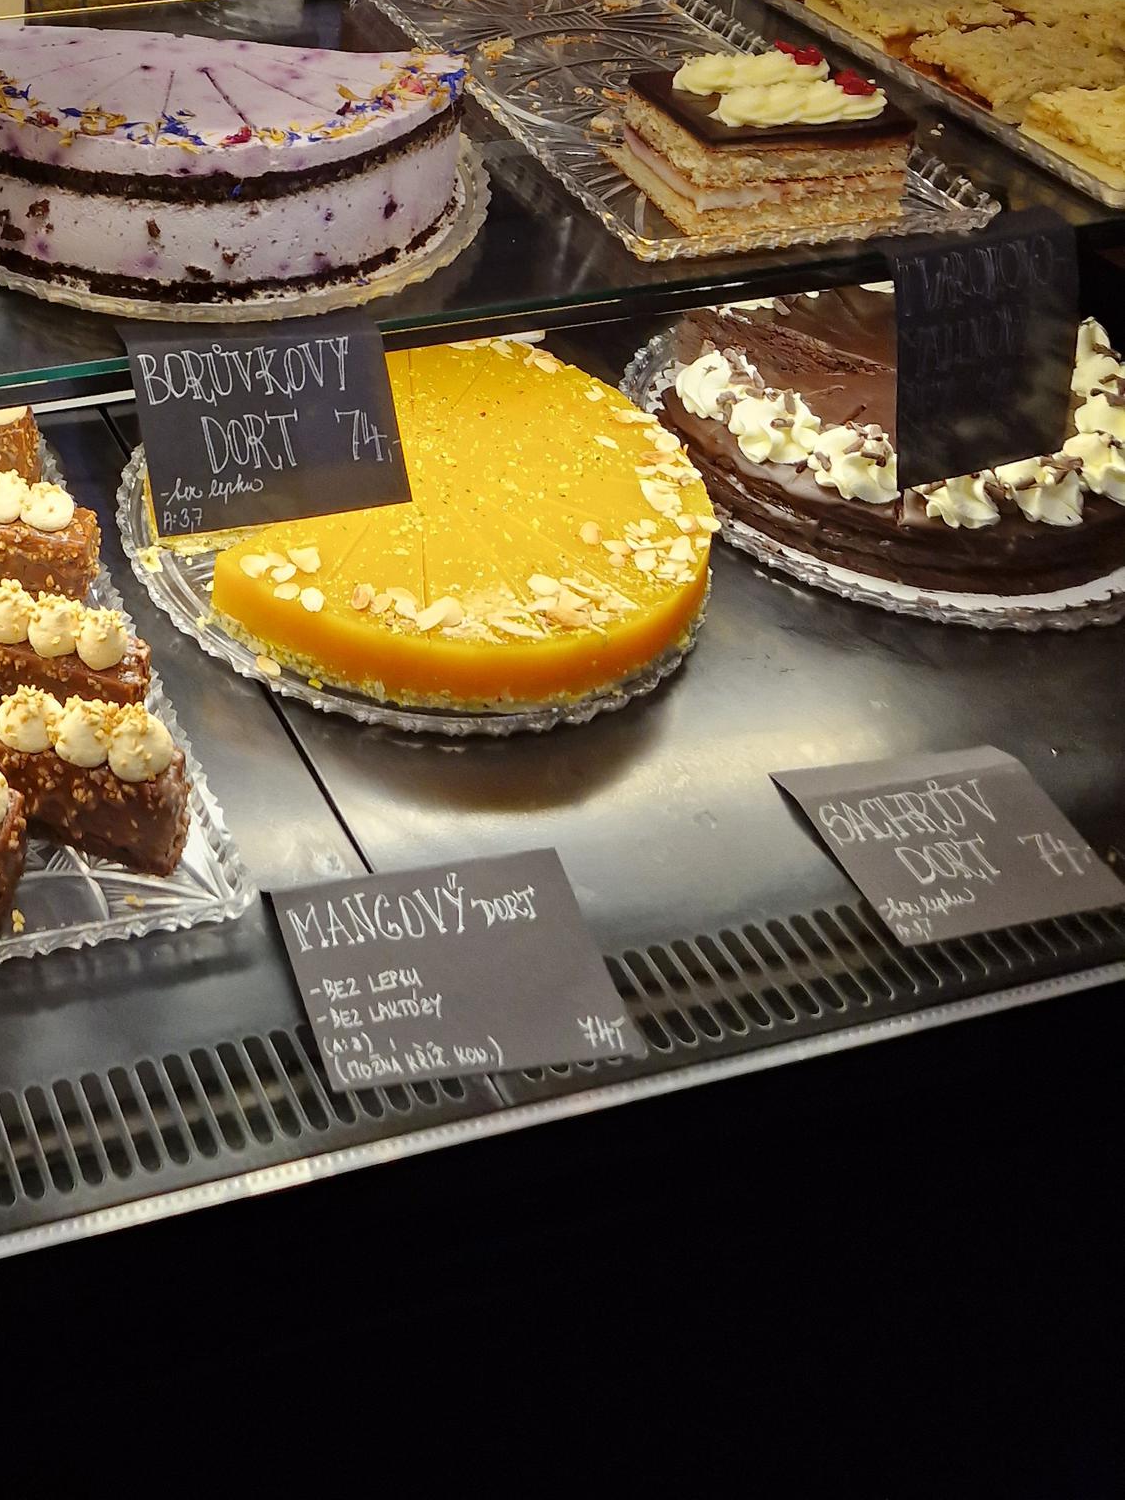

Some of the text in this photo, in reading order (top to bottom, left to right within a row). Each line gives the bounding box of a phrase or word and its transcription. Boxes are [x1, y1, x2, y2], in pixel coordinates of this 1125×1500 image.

[201, 408, 298, 475] DORT
[334, 408, 402, 464] 74,-
[207, 473, 264, 505] lepku
[894, 832, 1002, 885] DORT
[470, 884, 537, 930] DORT
[367, 967, 424, 994] LEPKU
